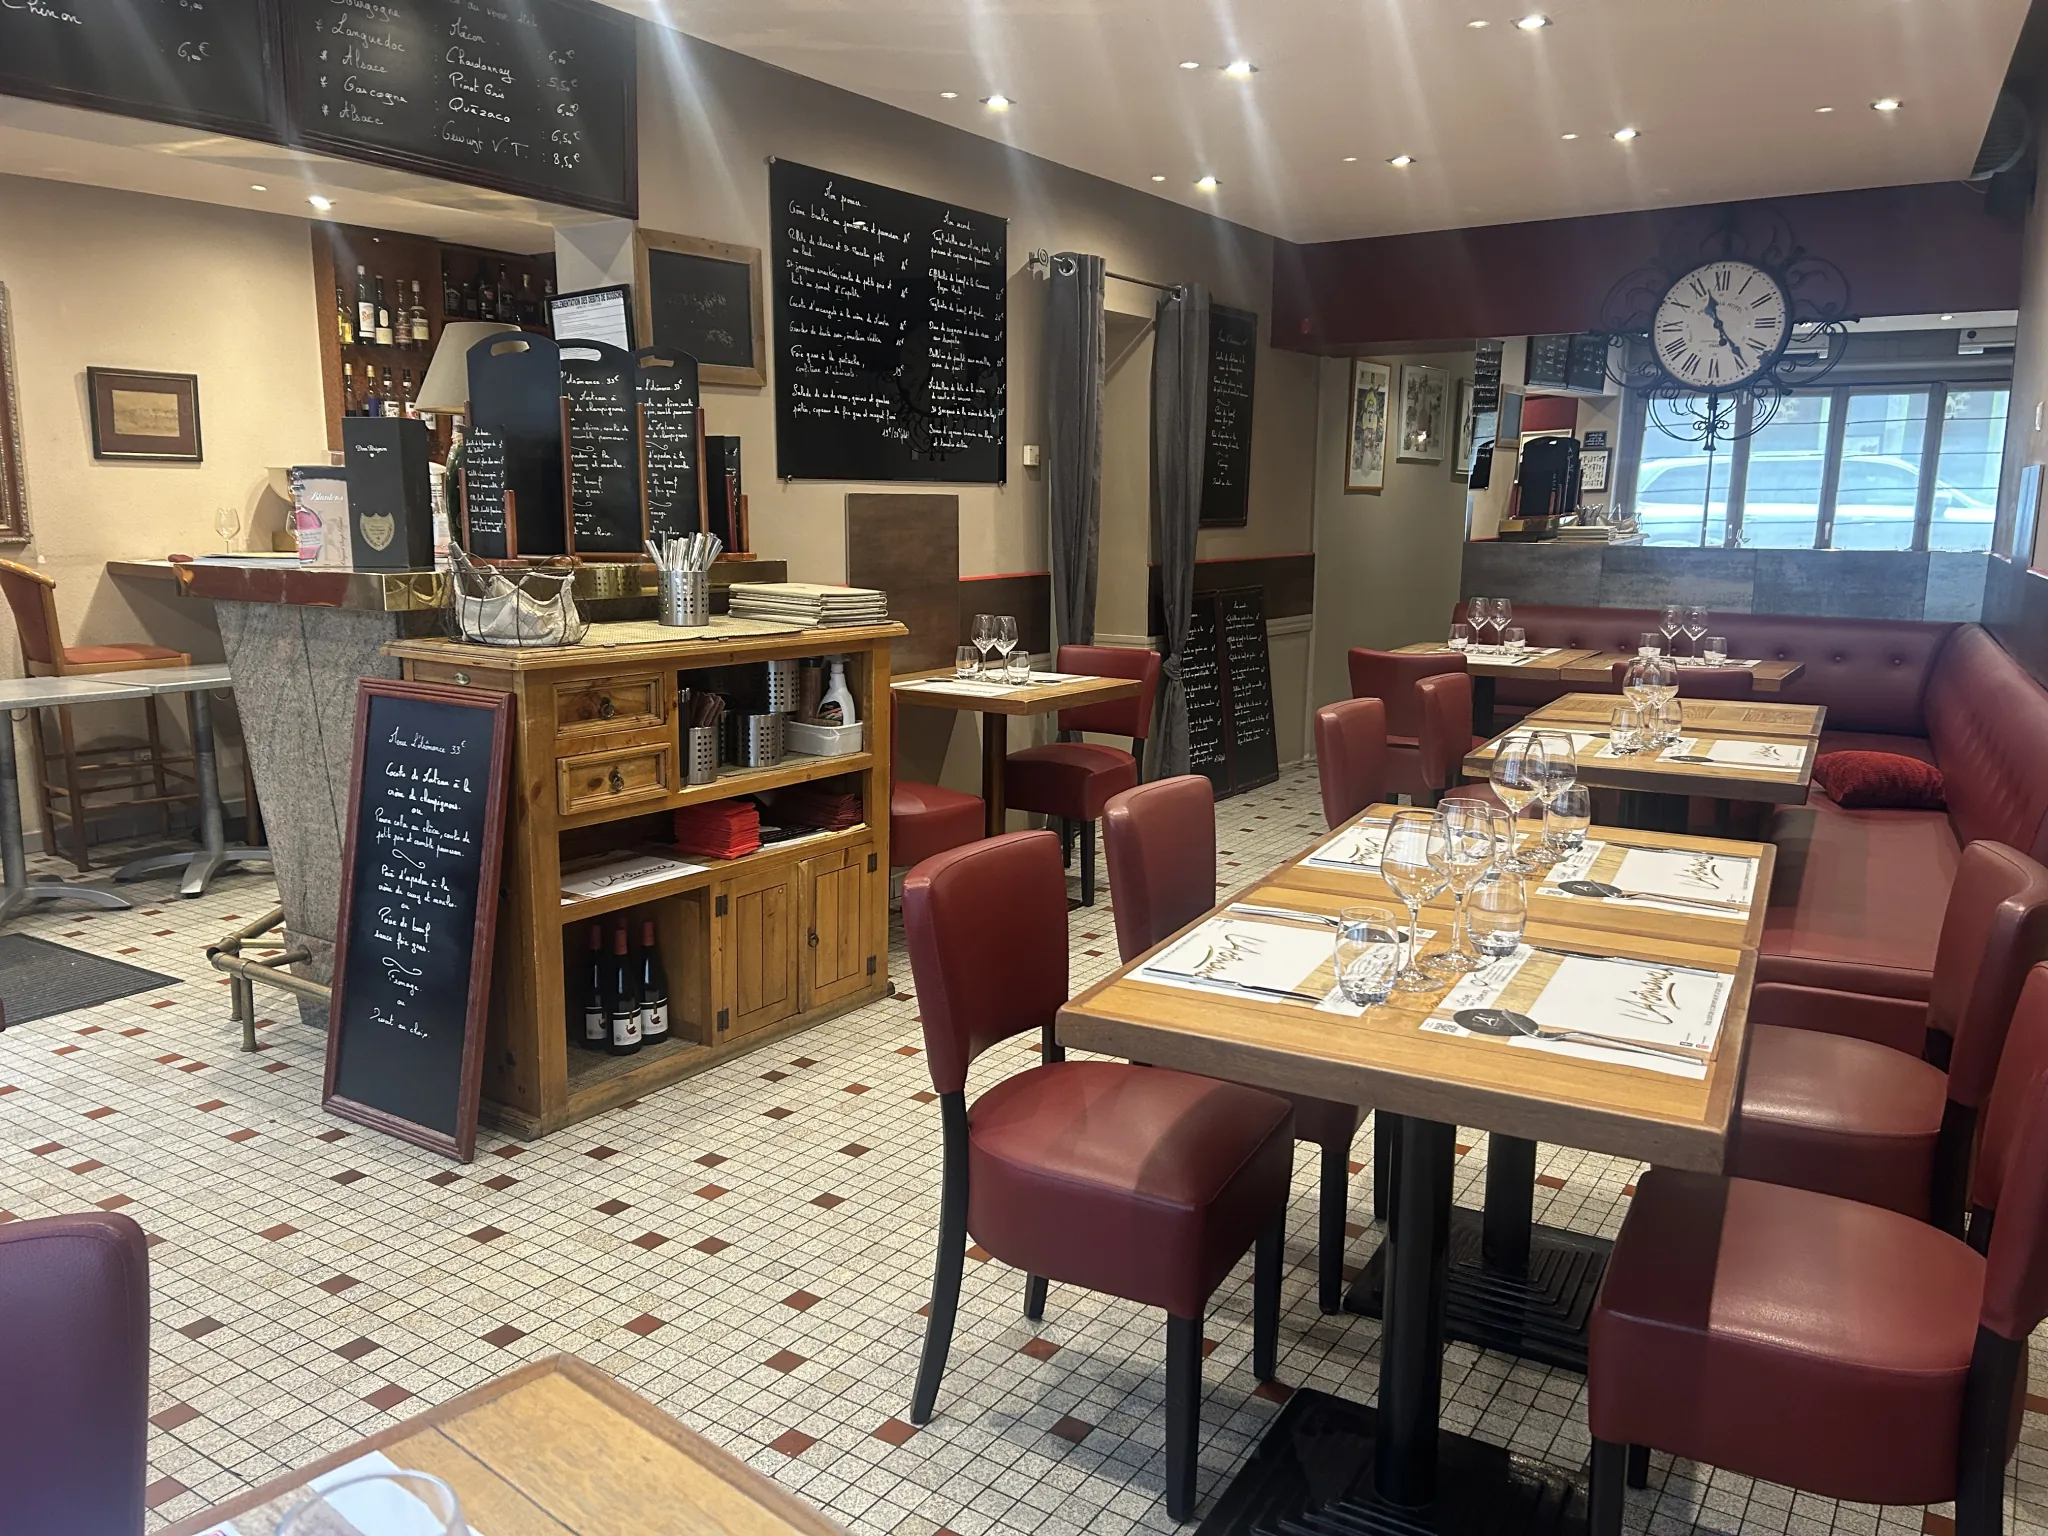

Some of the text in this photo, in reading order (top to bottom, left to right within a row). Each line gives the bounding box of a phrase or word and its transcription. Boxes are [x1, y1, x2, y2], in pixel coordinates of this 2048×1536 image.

[332, 12, 405, 49] Languedoc
[446, 46, 515, 84] Chardonnay
[343, 44, 388, 73] Alsace
[411, 768, 418, 780] de
[464, 778, 471, 792] la
[409, 788, 416, 800] de
[407, 832, 412, 842] et
[463, 831, 470, 843] de
[441, 877, 449, 891] la
[395, 885, 403, 894] de
[424, 891, 430, 902] et
[400, 917, 407, 927] de
